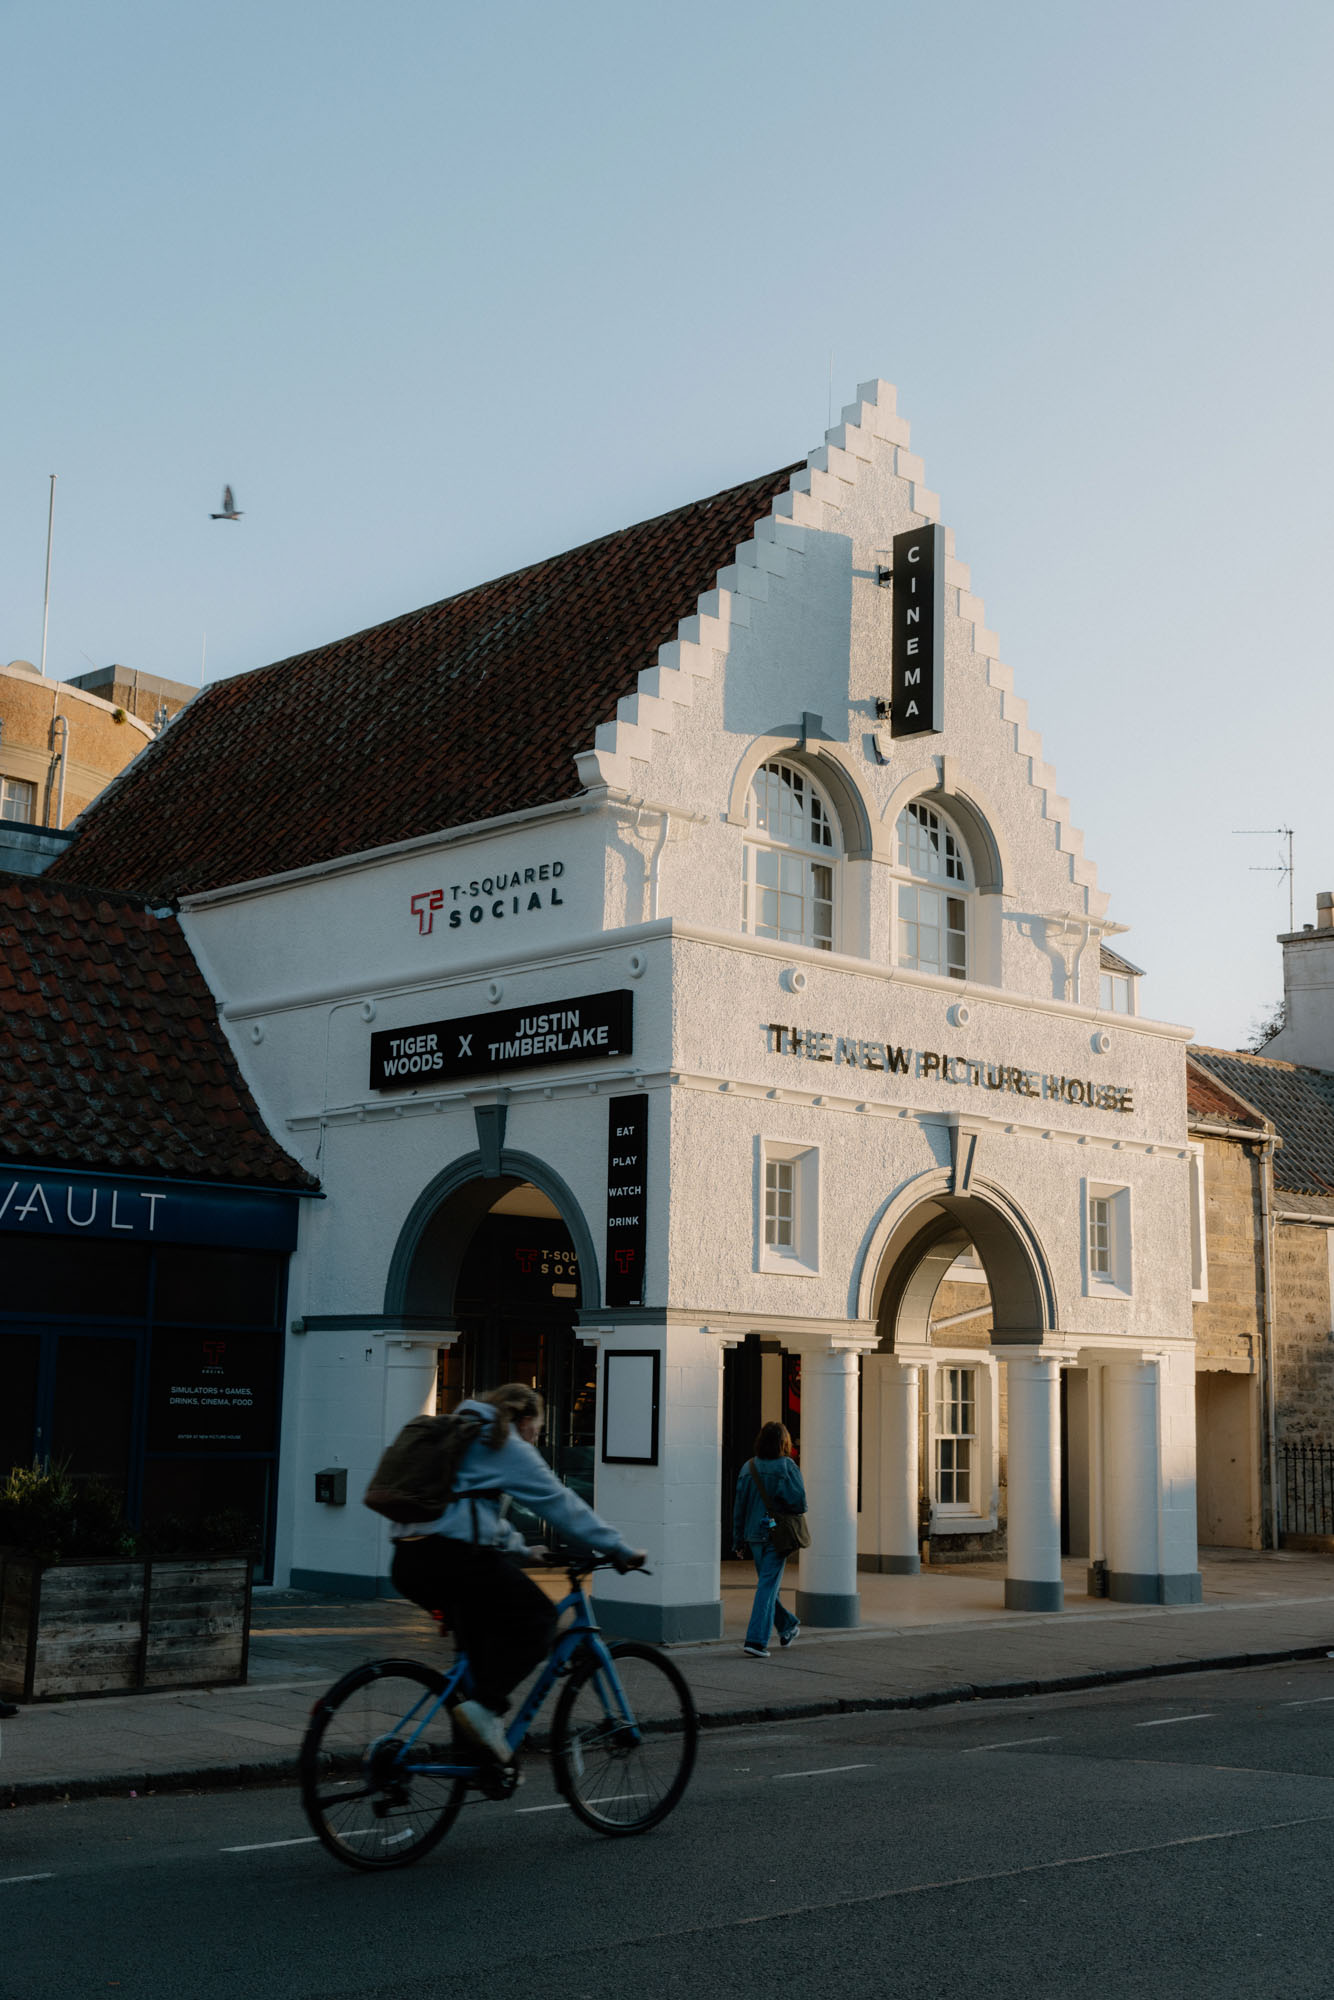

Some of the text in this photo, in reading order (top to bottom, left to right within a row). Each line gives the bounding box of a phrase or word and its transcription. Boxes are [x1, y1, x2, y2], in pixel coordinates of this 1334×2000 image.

[904, 546, 921, 718] CINEMA
[450, 861, 564, 901] T-SQUARED
[449, 888, 564, 928] SOCIAL
[515, 1010, 580, 1037] JUSTIN
[390, 1034, 438, 1057] TIGER
[457, 1034, 473, 1058] X
[488, 1025, 609, 1062] TIMBERLAKE
[383, 1052, 444, 1077] WOODS
[768, 1023, 1135, 1113] THE NEW PICTURE HOUSE
[616, 1126, 635, 1137] EAT
[612, 1155, 637, 1166] PLAY
[608, 1186, 642, 1197] WATCH
[609, 1216, 639, 1227] DRINK
[169, 1397, 253, 1406] DRINKS, CINEMA, FOOD
[171, 1386, 219, 1395] SIMULATORS
[225, 1388, 253, 1396] GAMES,
